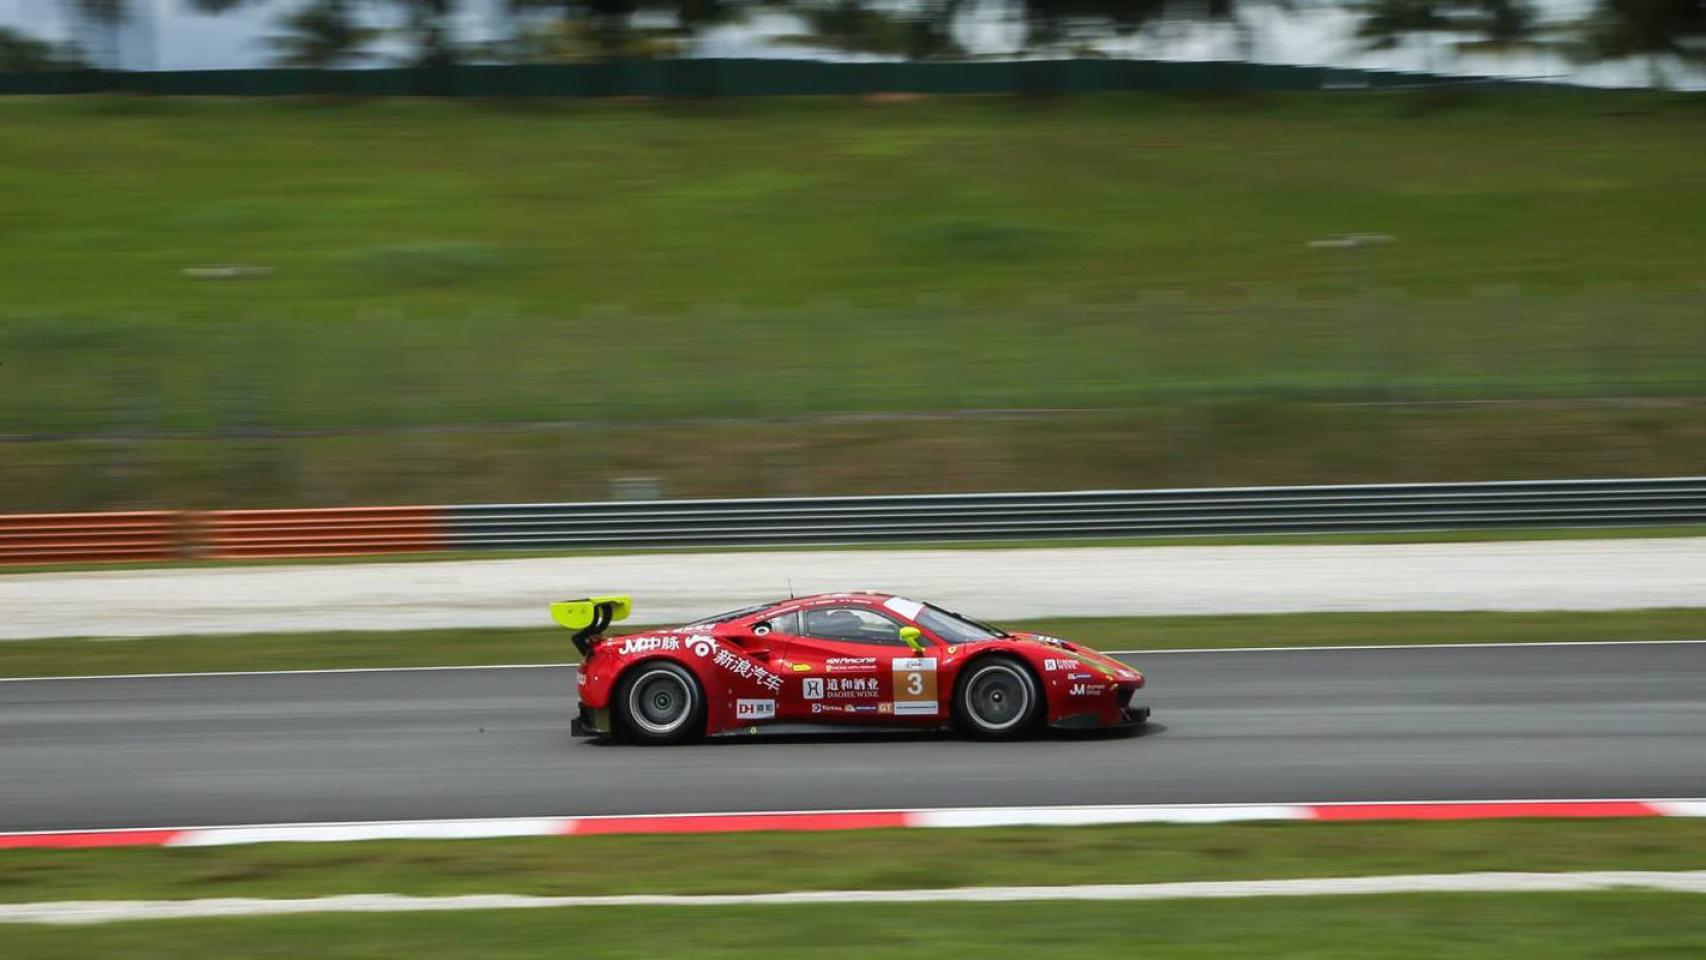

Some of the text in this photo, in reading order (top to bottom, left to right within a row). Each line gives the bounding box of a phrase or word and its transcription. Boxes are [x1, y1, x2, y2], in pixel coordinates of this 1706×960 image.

[714, 650, 784, 690] 新浪汽车
[827, 678, 879, 691] 道和酒业
[907, 672, 924, 695] 3
[857, 690, 879, 698] WINE
